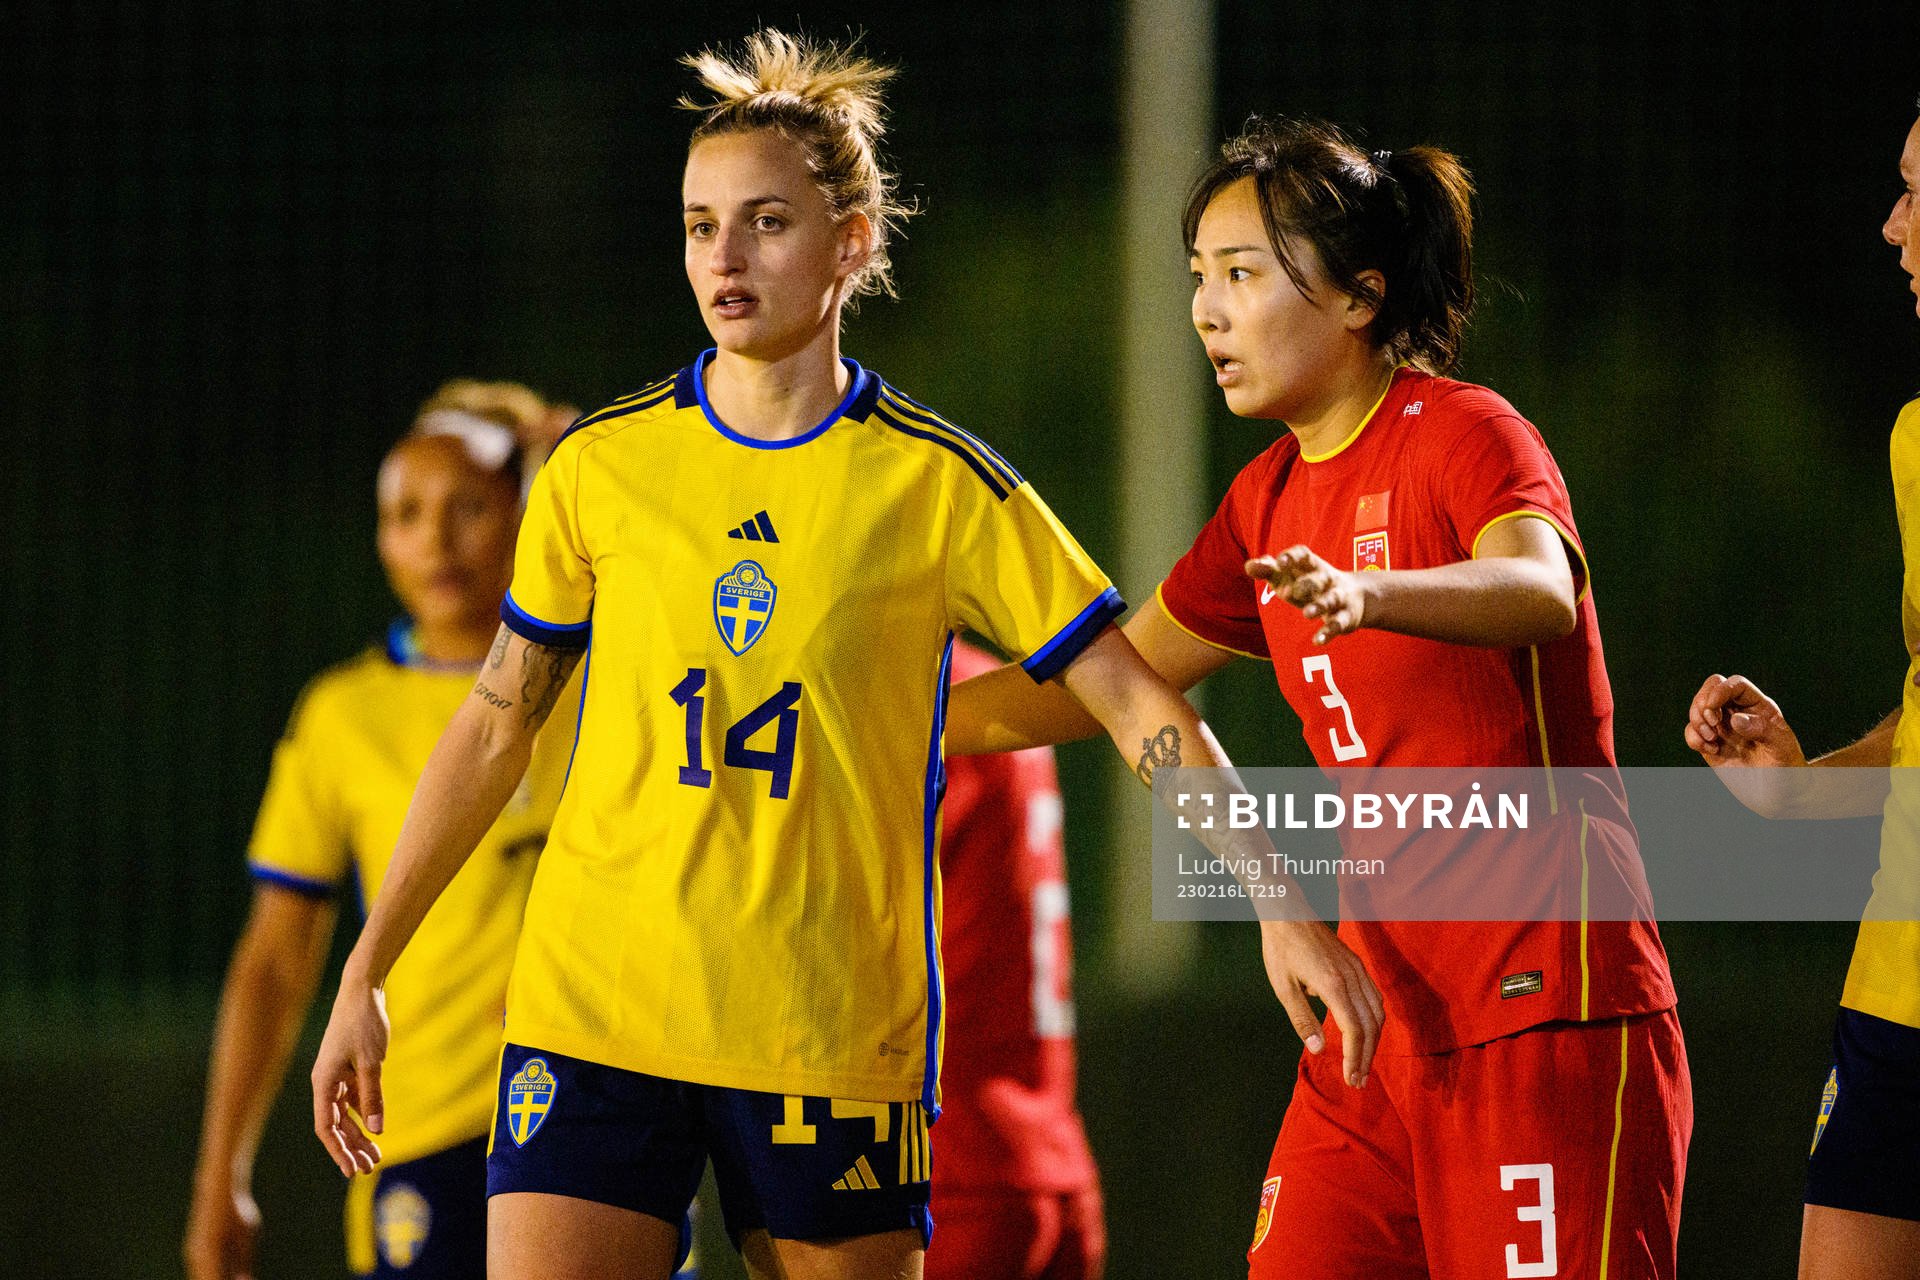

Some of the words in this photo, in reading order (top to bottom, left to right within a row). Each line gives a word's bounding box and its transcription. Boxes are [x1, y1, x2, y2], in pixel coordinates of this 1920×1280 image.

[726, 587, 765, 598] SVERIGE
[1357, 539, 1384, 556] CFA
[668, 667, 803, 800] 14
[1302, 654, 1367, 762] 3
[1500, 1163, 1557, 1279] 3
